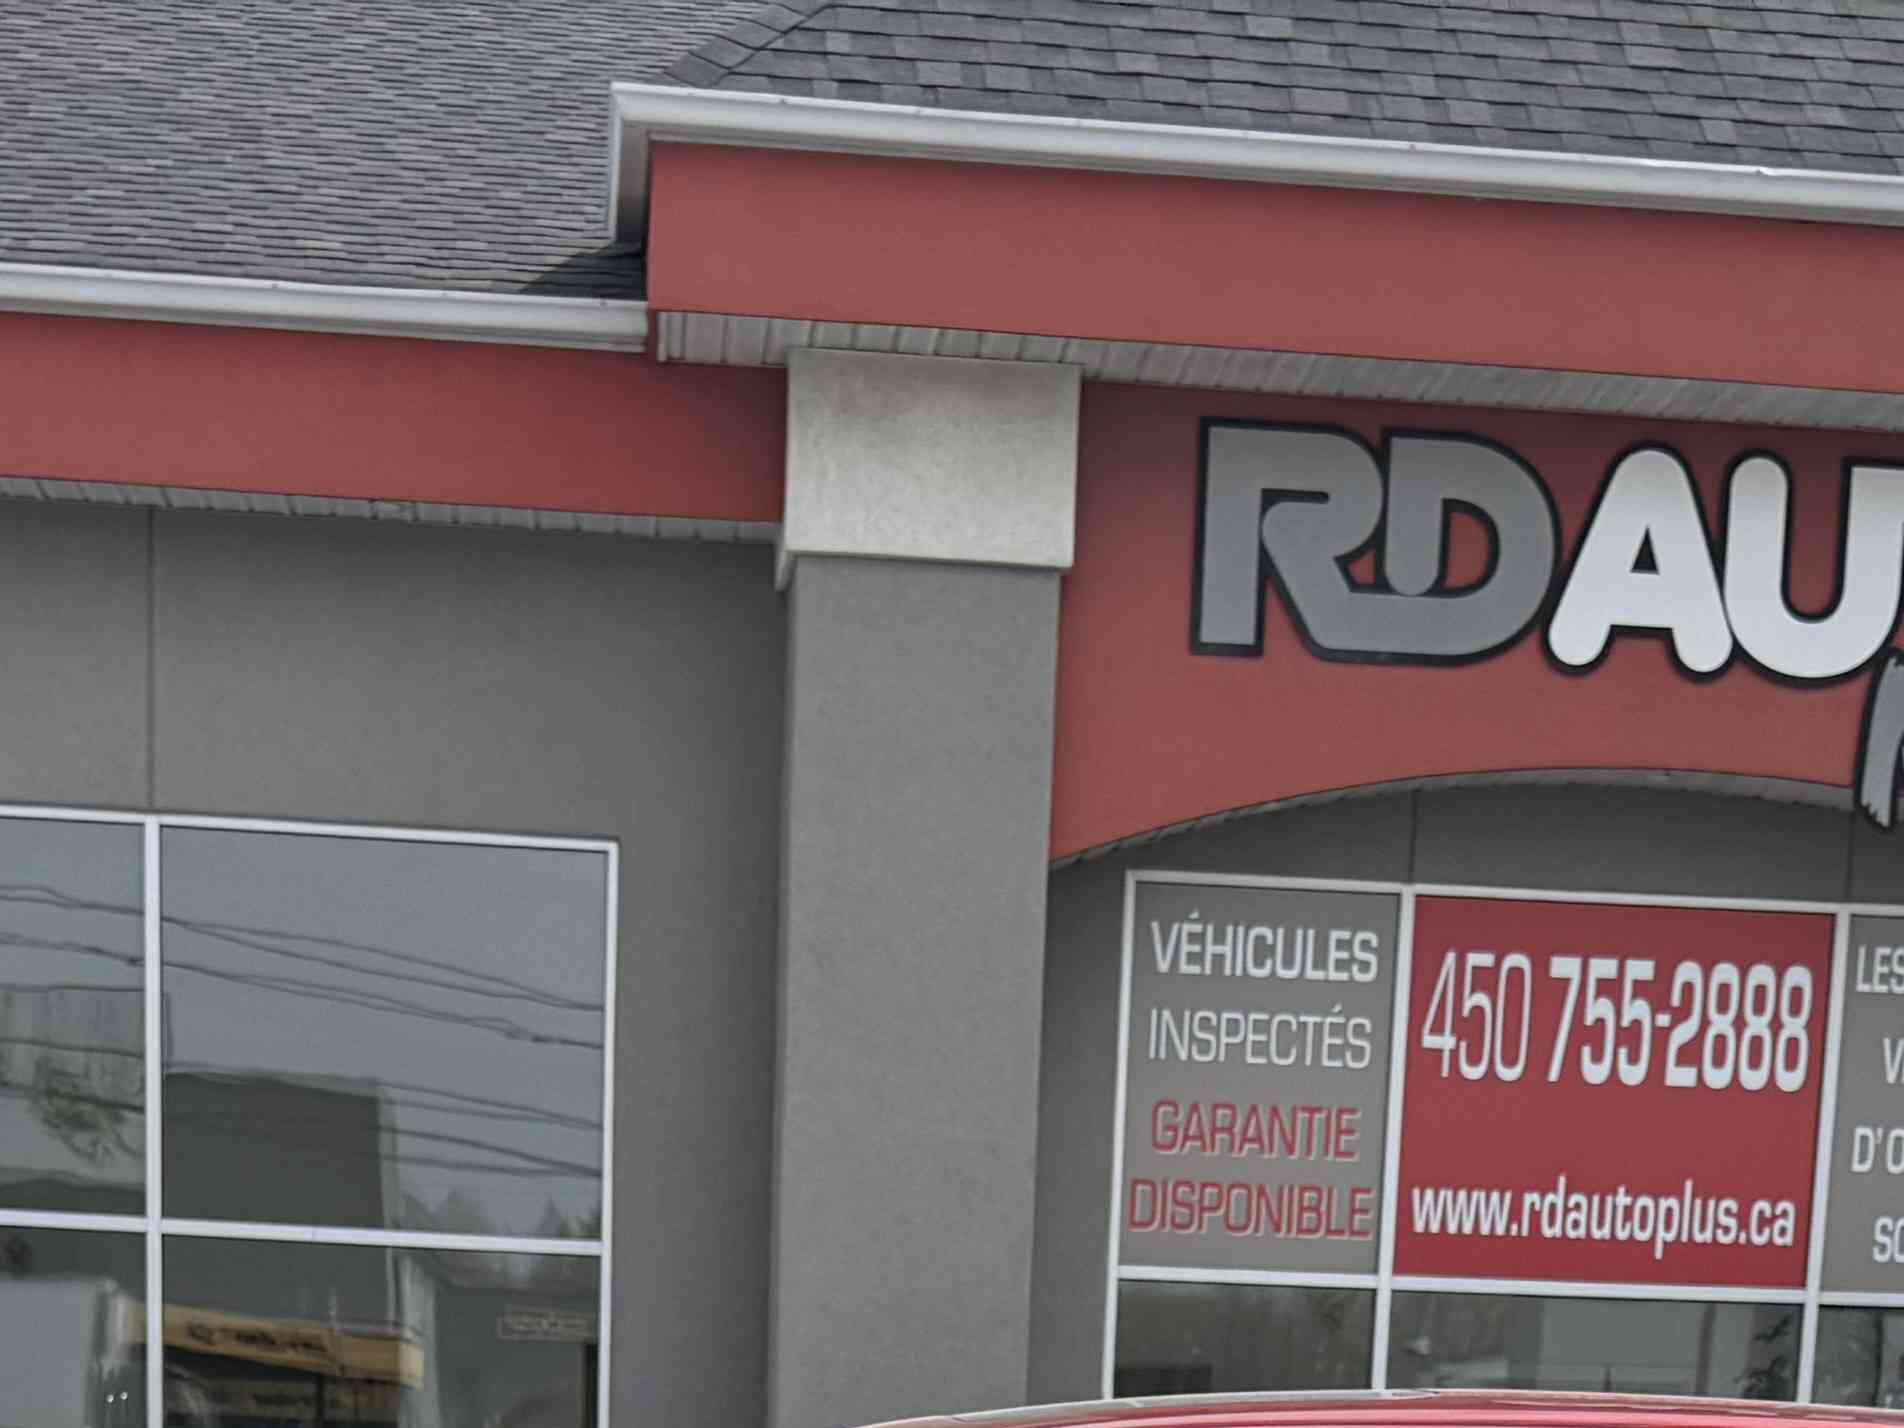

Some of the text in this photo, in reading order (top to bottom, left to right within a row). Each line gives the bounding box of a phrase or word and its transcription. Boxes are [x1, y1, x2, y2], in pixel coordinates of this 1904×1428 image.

[1150, 909, 1380, 982] VÉHICULES
[1148, 1003, 1373, 1069] INSPECTÉS
[1421, 951, 1813, 1092] 450 755-2888
[1151, 1098, 1362, 1162] GARANTIE
[1128, 1177, 1377, 1240] DISPONIBLE
[1411, 1173, 1796, 1260] www.rdautoplus.ca
